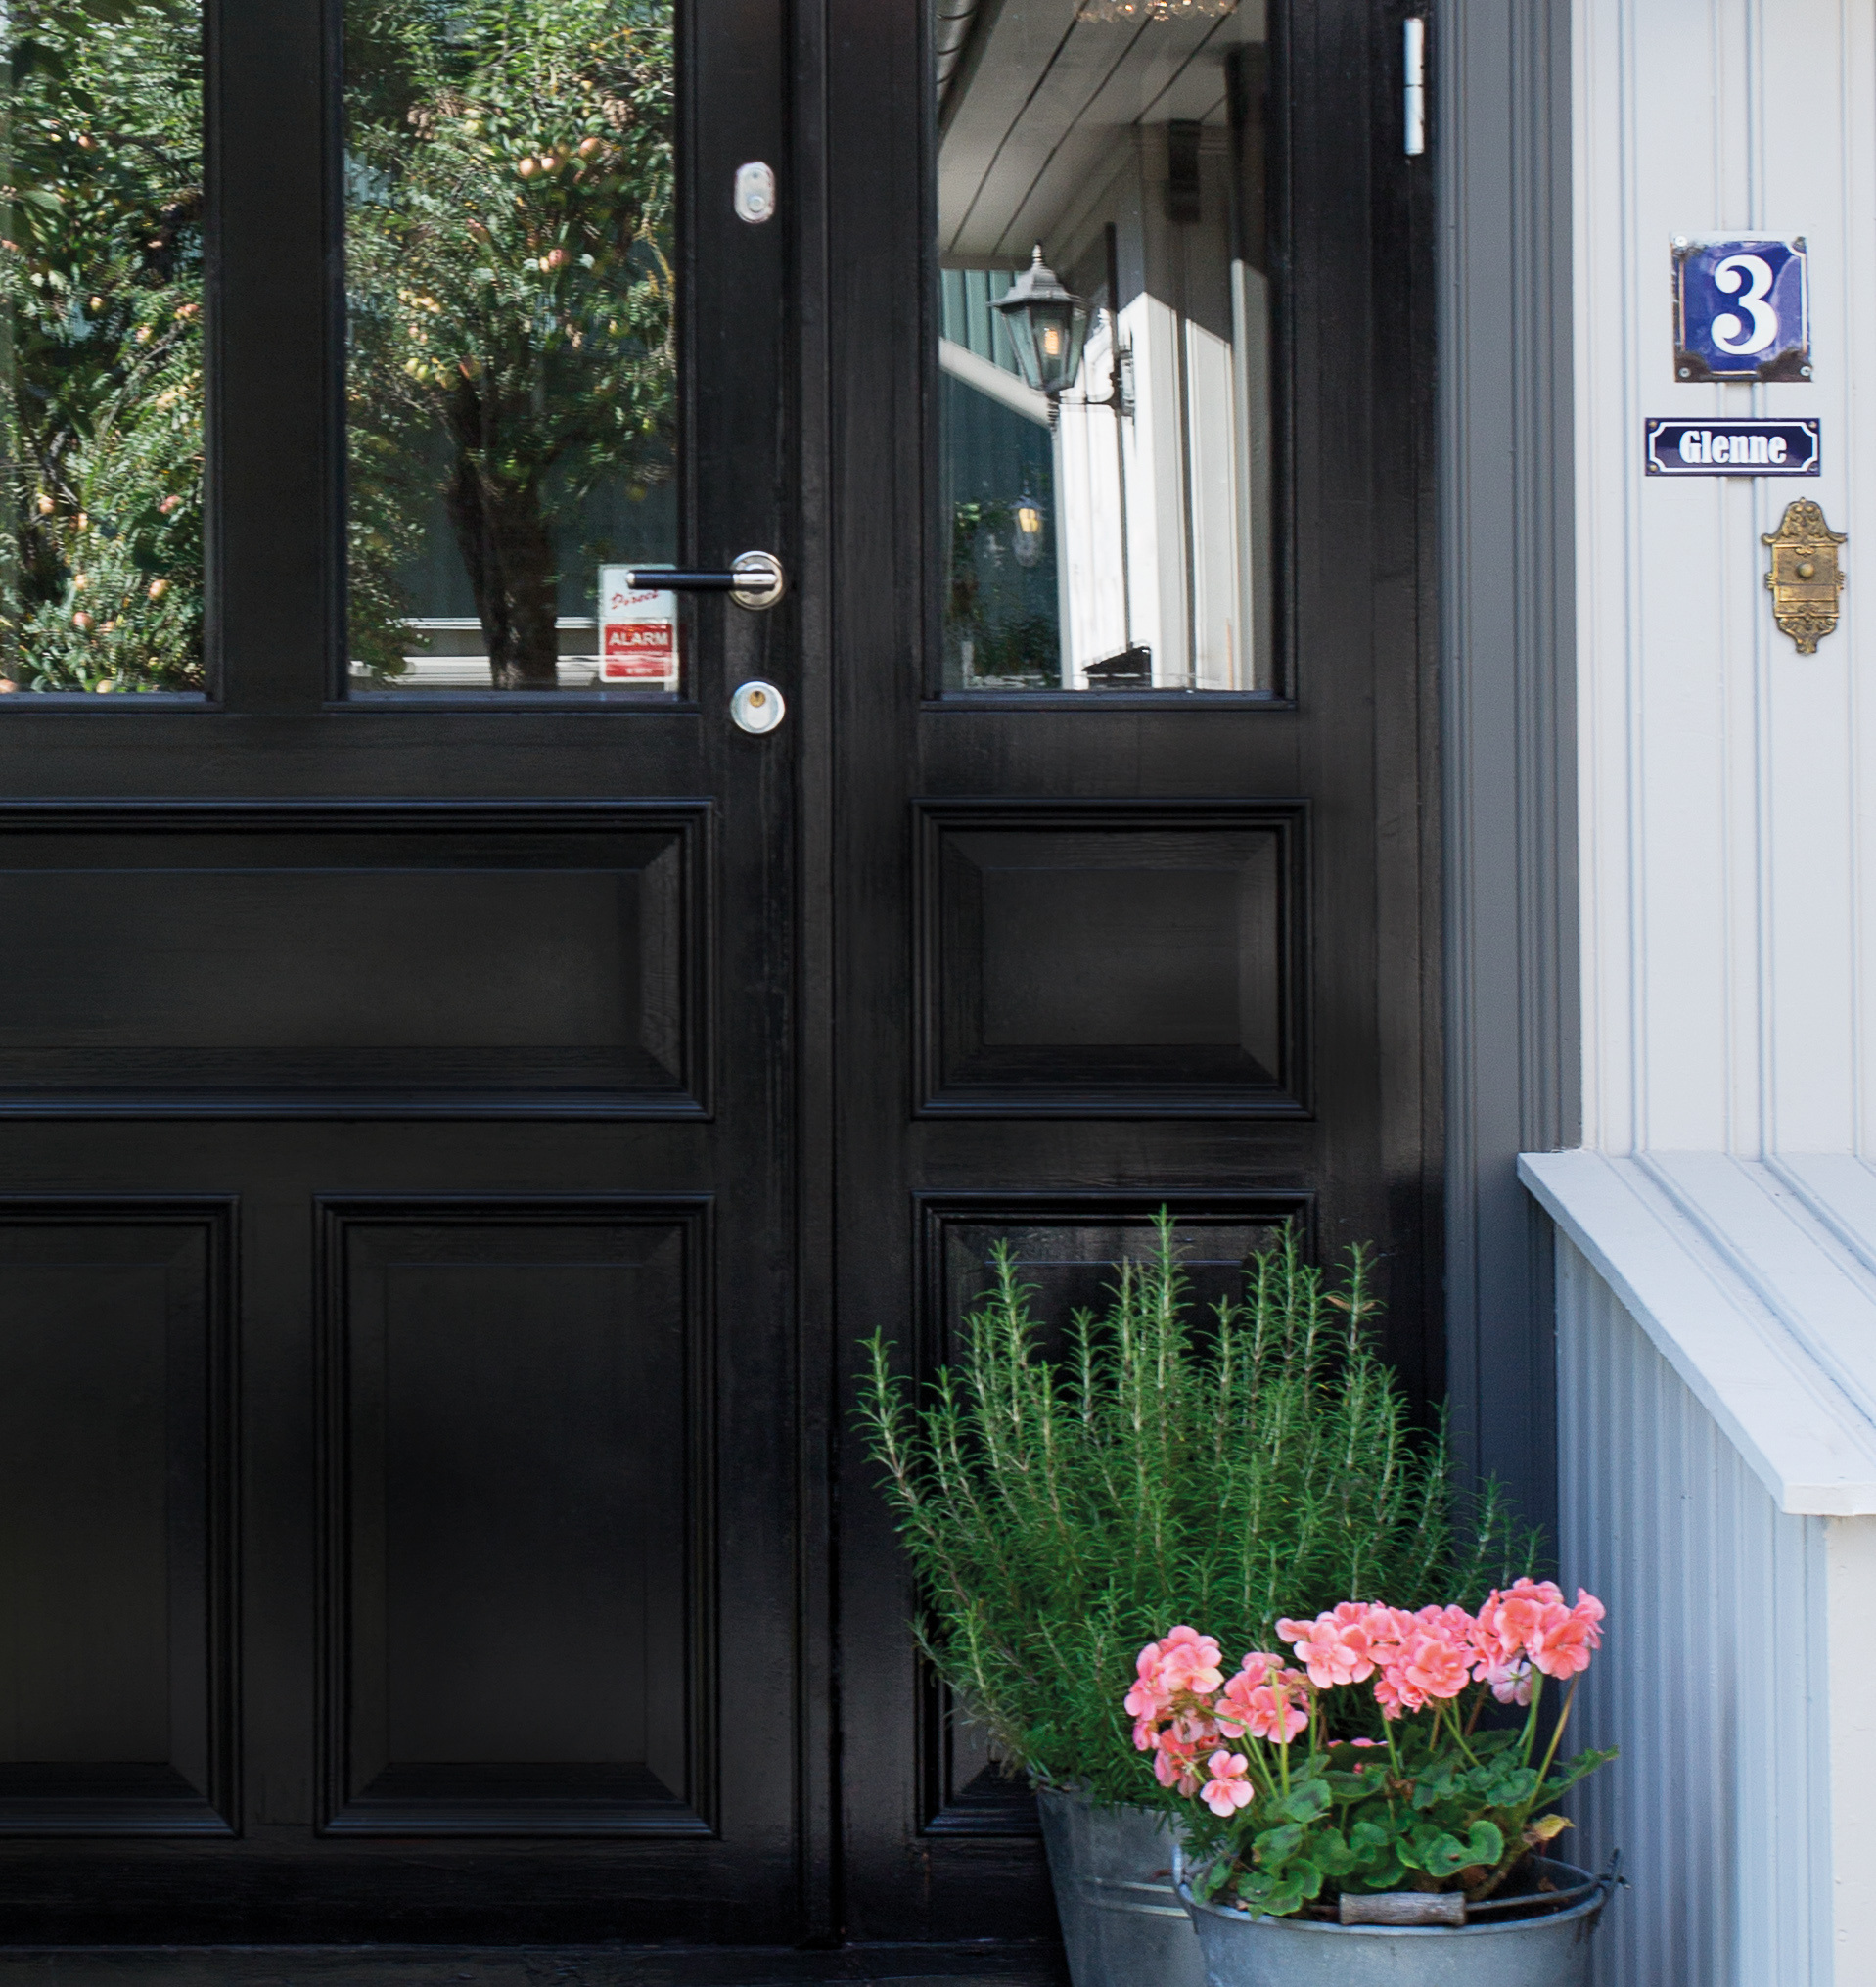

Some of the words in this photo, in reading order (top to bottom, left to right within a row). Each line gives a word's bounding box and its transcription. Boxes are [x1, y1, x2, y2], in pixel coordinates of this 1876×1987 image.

[1711, 254, 1778, 355] 3
[1679, 431, 1787, 464] Glenne
[608, 631, 669, 646] ALARM
